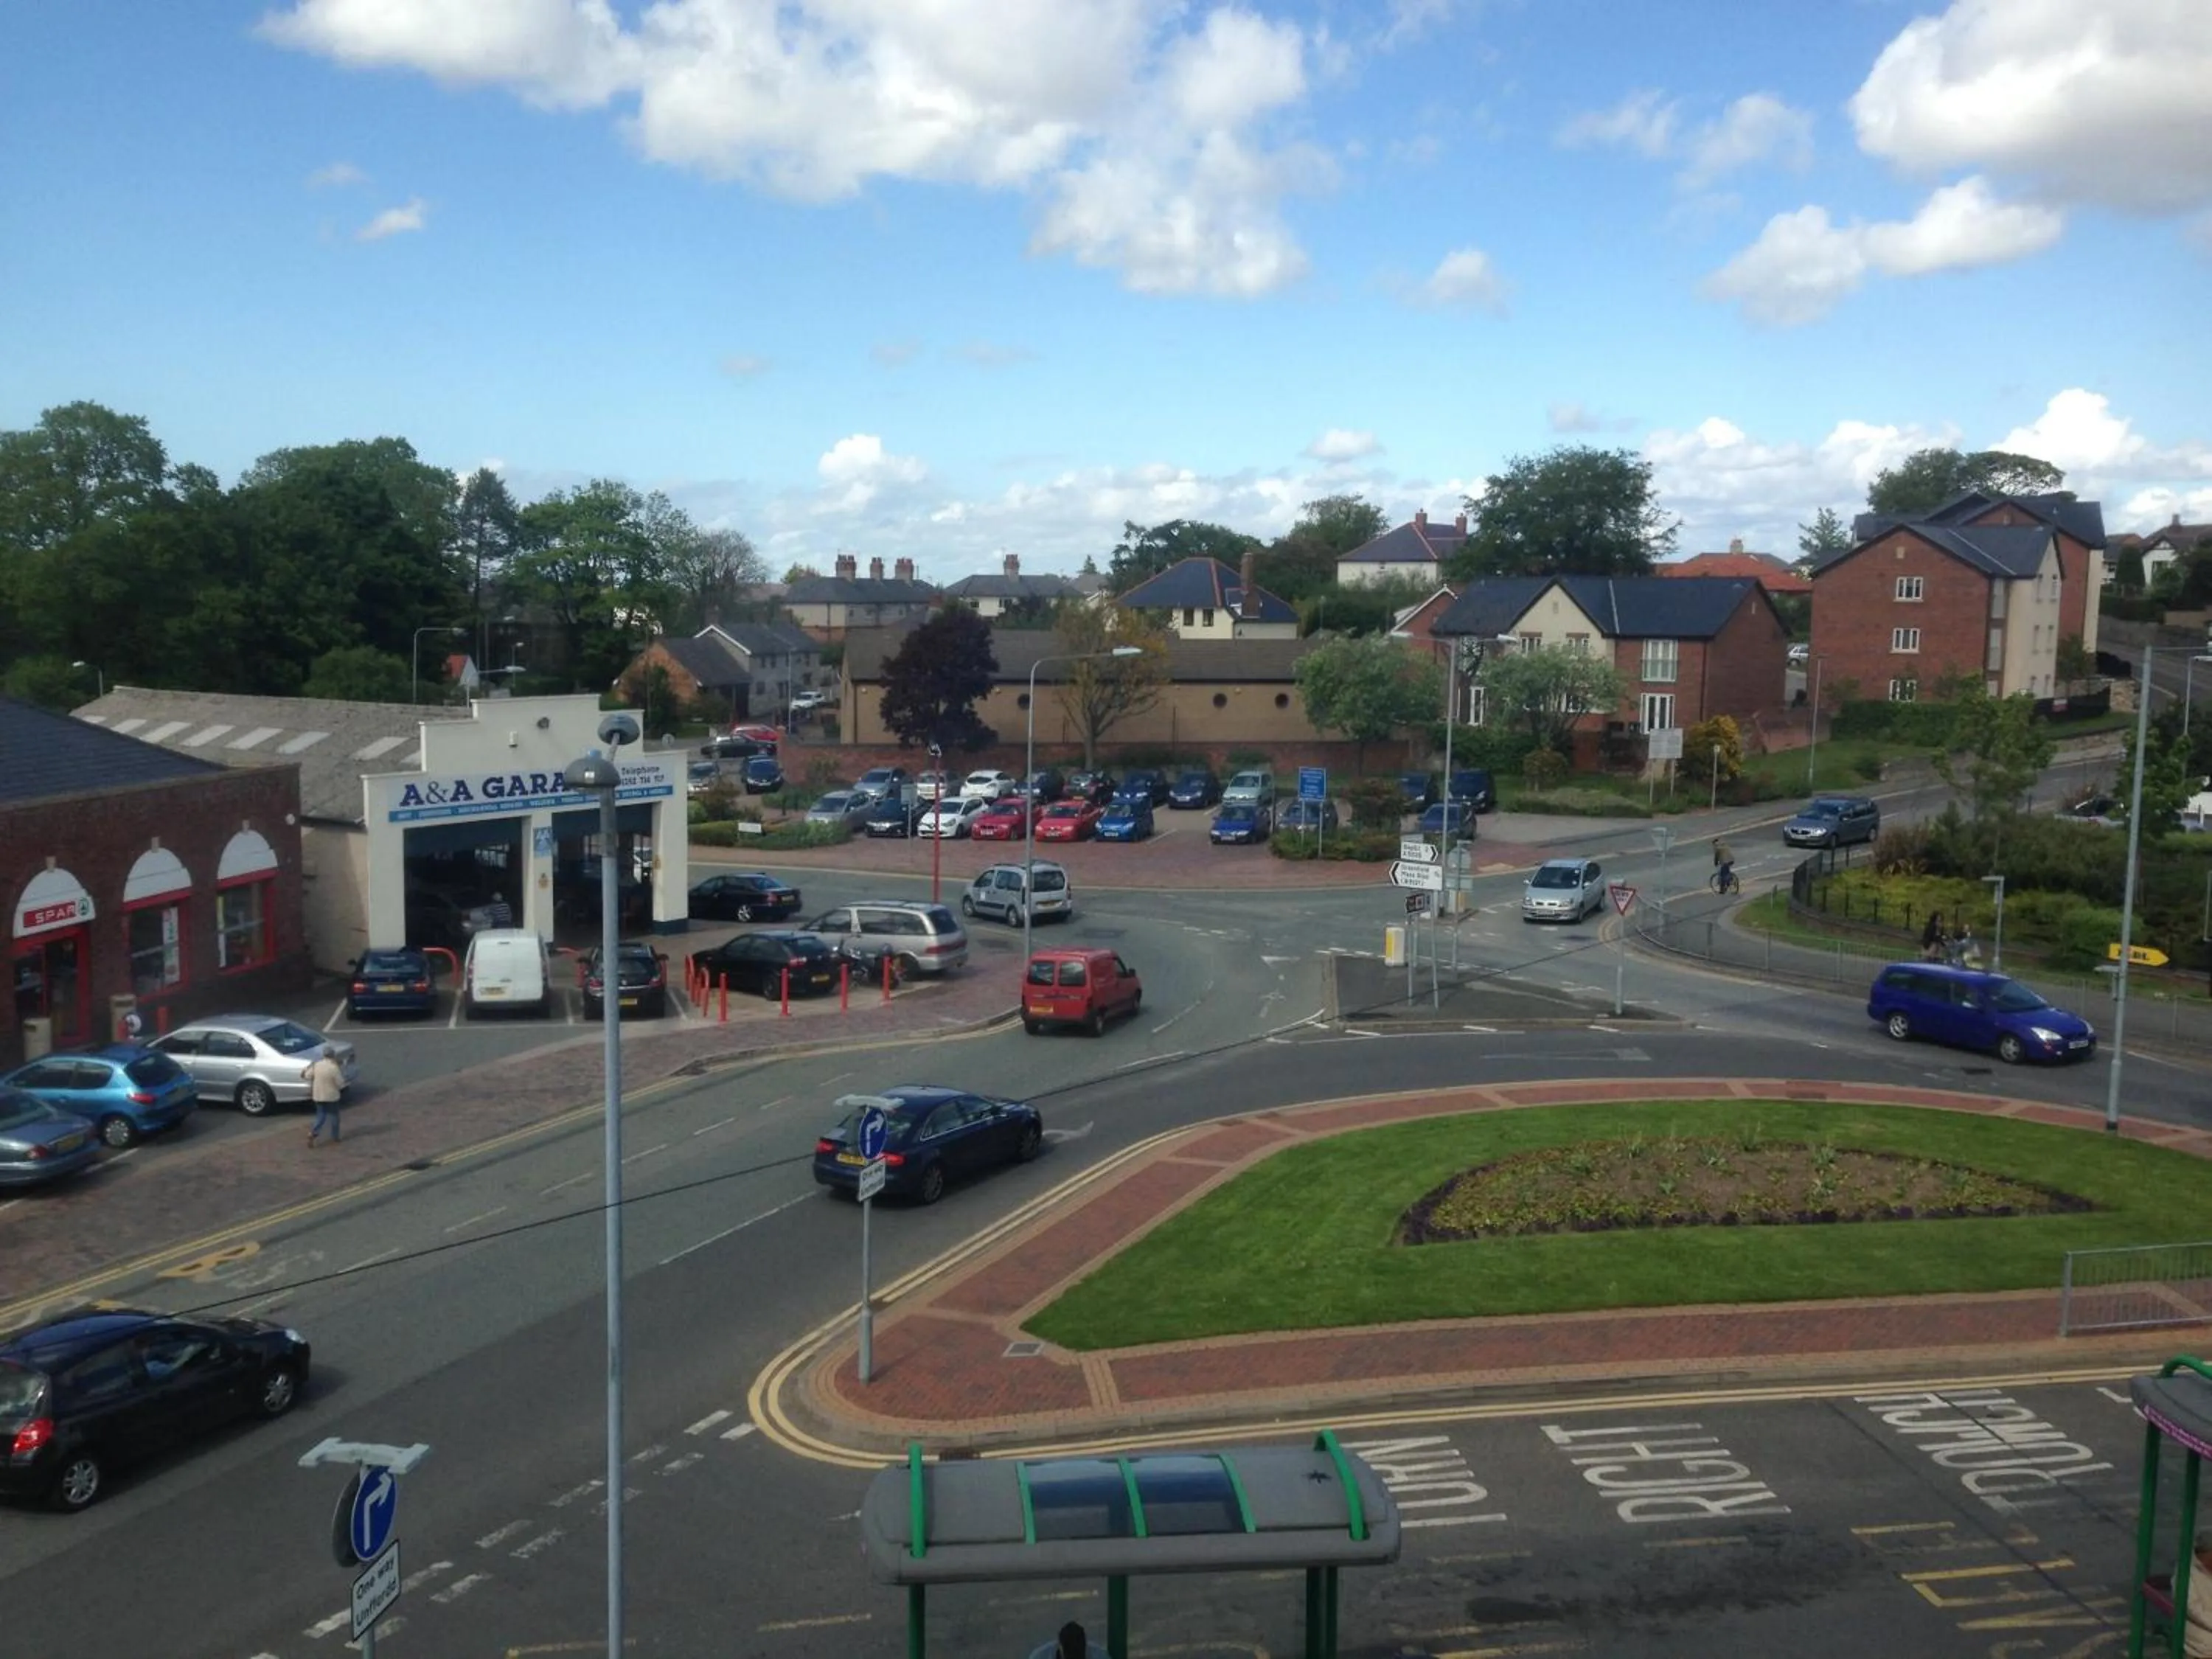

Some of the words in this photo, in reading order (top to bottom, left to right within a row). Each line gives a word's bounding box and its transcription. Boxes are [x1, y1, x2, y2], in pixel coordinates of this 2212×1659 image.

[399, 778, 473, 807] A&A
[481, 771, 572, 799] GARA
[35, 905, 75, 925] SPAR
[1540, 1423, 1792, 1523] RIGHT
[356, 1576, 375, 1600] One
[378, 1556, 394, 1579] way
